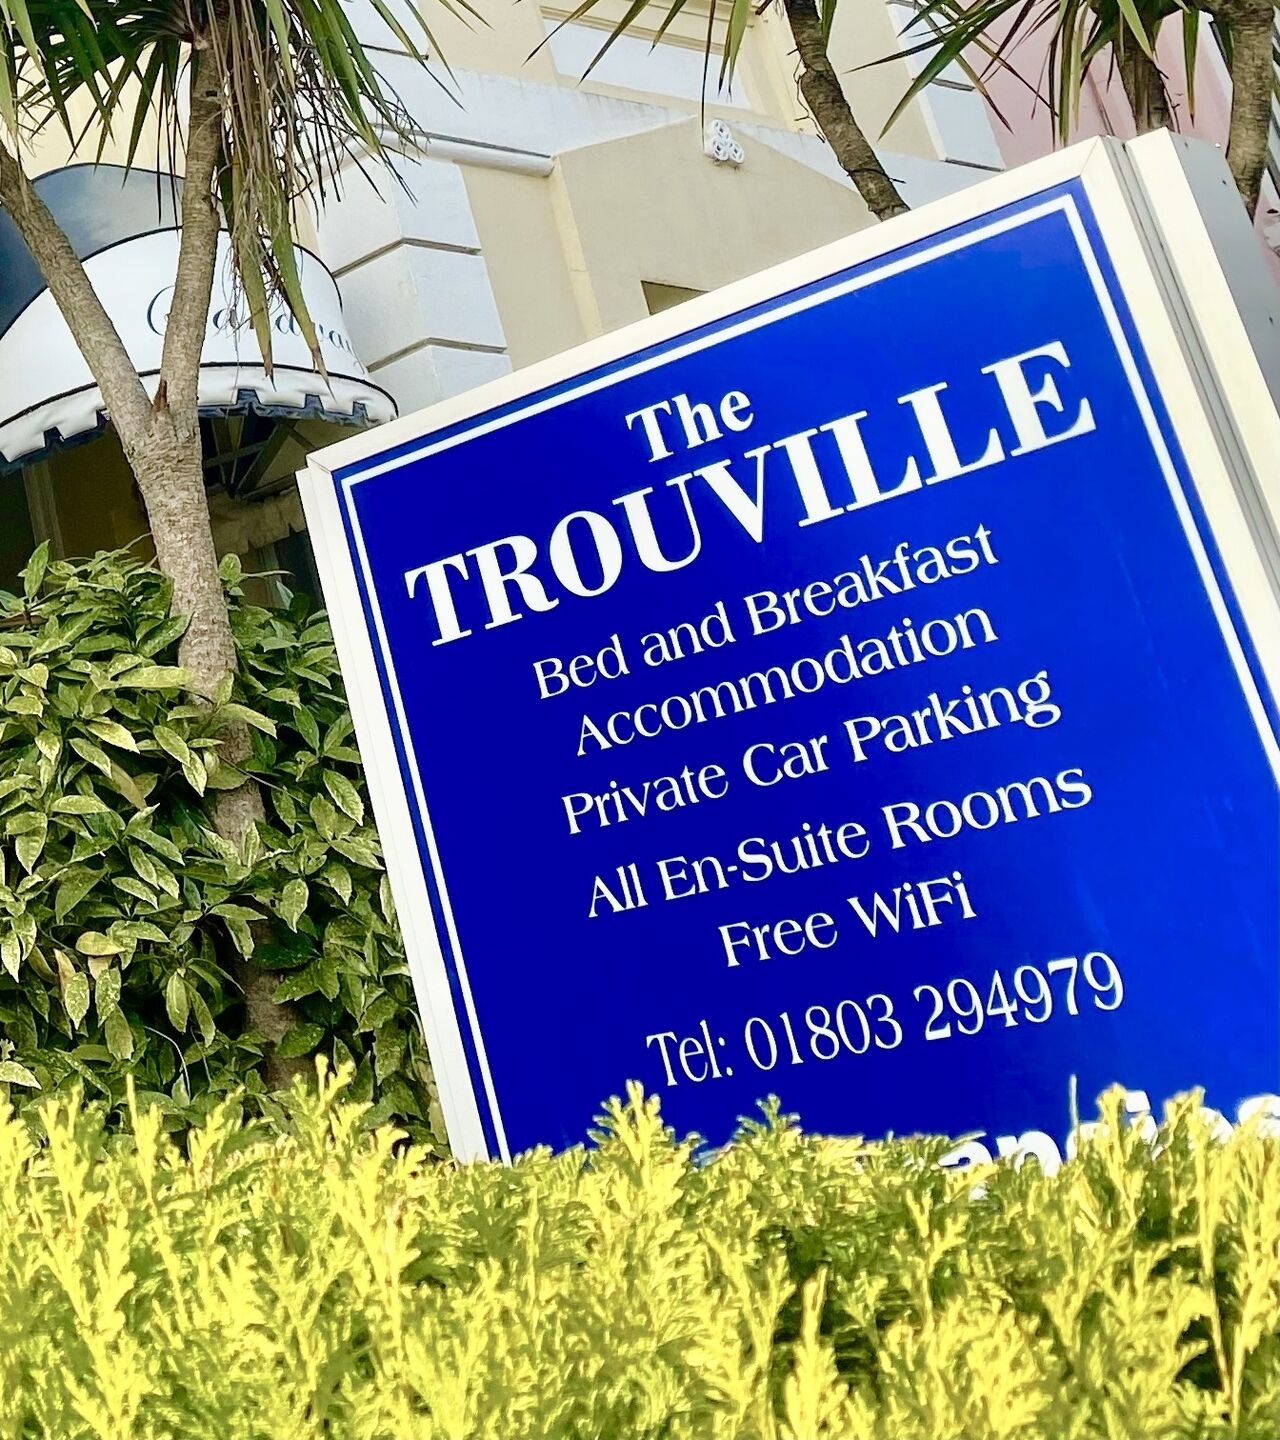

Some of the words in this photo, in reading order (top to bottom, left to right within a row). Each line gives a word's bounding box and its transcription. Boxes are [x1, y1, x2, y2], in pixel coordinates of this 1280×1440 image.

[404, 340, 1097, 647] TROUVILLE
[624, 389, 755, 463] The
[532, 633, 631, 701] Bed
[640, 600, 737, 667] and
[743, 522, 1000, 637] Breakfast
[575, 605, 1000, 757] Accommodation
[560, 762, 730, 835] Private
[742, 732, 830, 787] Car
[843, 670, 1063, 763] Parking
[587, 862, 649, 918] All
[656, 818, 870, 901] En-Suite
[881, 767, 1093, 850] Rooms
[717, 911, 838, 968] Free
[846, 868, 978, 938] WiFi
[645, 1018, 734, 1087] Tel:
[744, 993, 903, 1071] 01803
[913, 951, 1124, 1041] 294979
